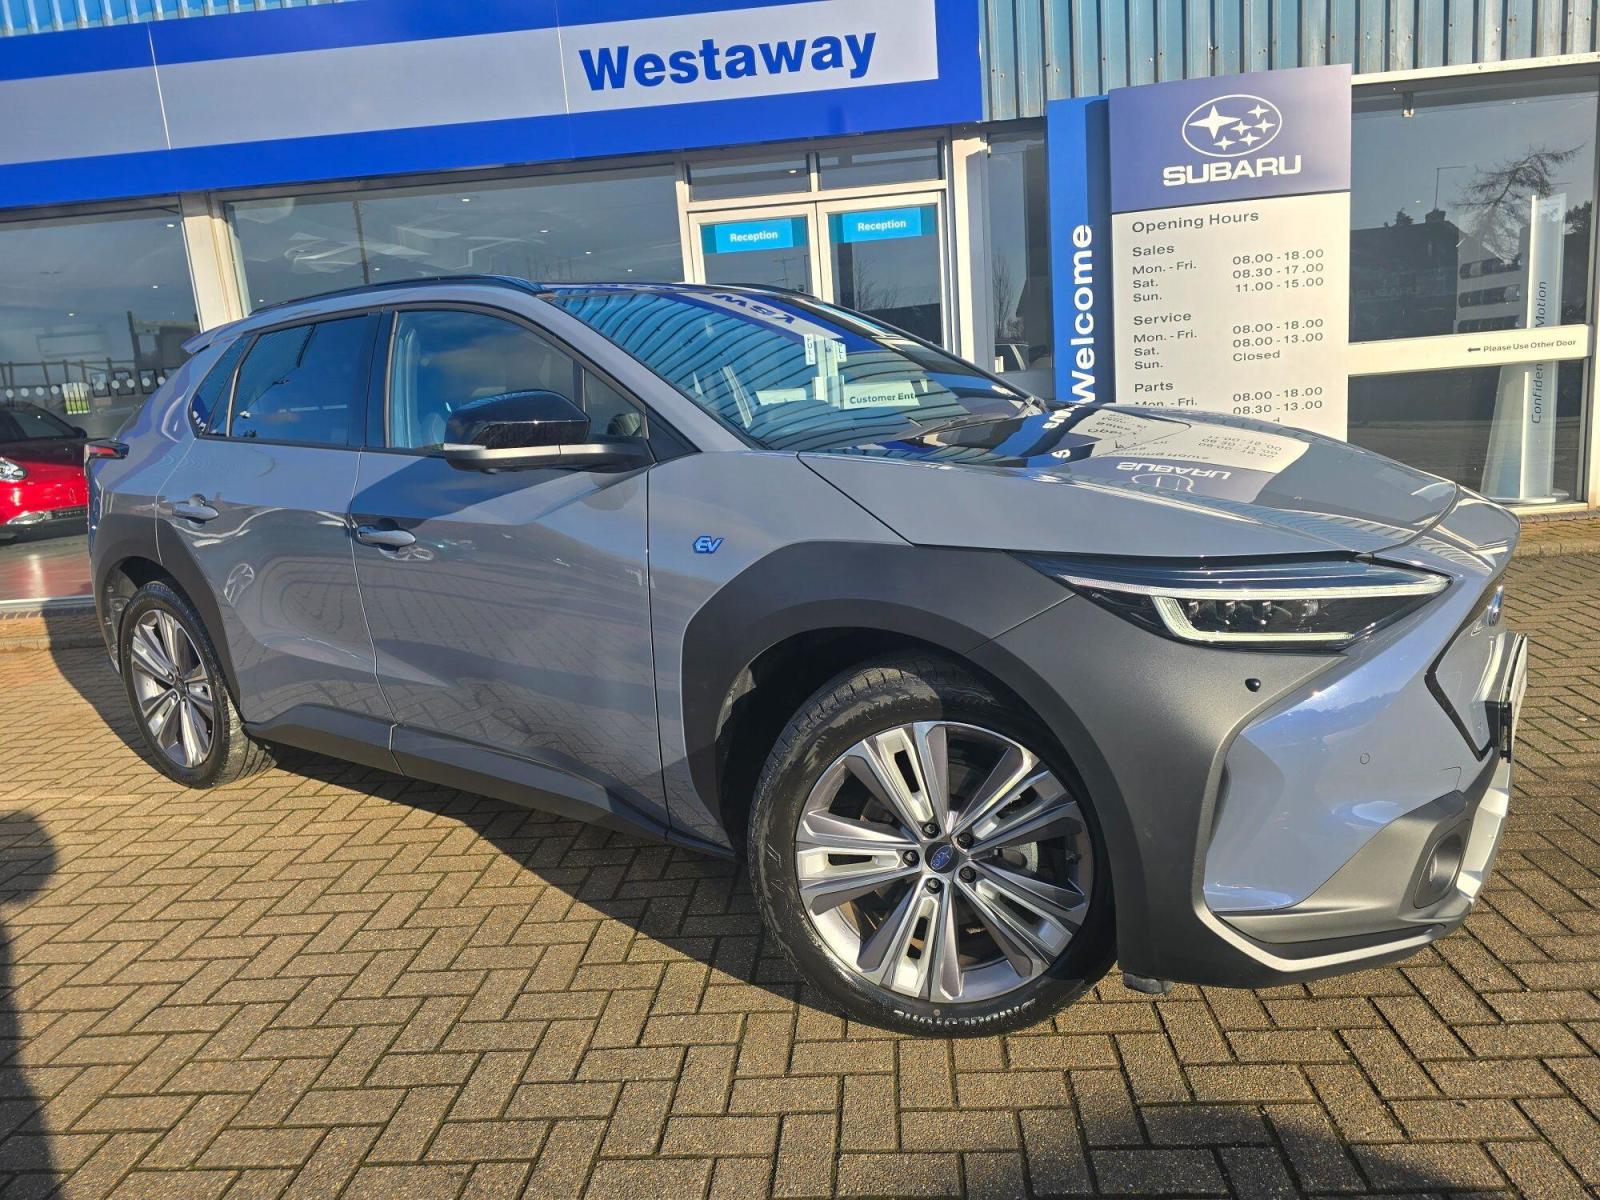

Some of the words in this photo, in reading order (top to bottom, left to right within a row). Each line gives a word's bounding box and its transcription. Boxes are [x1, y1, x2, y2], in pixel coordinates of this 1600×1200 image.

[578, 32, 877, 91] Westaway
[1163, 155, 1302, 187] SUBARU
[857, 219, 907, 232] Reception
[1132, 217, 1204, 234] Opening
[1209, 212, 1259, 225] Hours
[729, 230, 778, 242] Reception
[1132, 245, 1175, 257] Sales
[1232, 253, 1273, 265] 08.00
[1284, 249, 1324, 261] 18.00
[1132, 265, 1166, 275] Mon.
[1176, 260, 1197, 271] Fri.
[1232, 267, 1273, 279] 08.30
[1284, 263, 1324, 275] 17.00
[1133, 278, 1159, 289] Sat.
[1236, 281, 1273, 293] 11.00
[1284, 277, 1324, 289] 15.00
[1133, 293, 1163, 303] Sun.
[1535, 281, 1547, 327] Motion
[1071, 225, 1096, 404] Welcome
[1133, 313, 1192, 326] Service
[1232, 322, 1273, 334] 08.00
[1284, 318, 1324, 330] 18.00
[1133, 333, 1167, 344] Mon.
[1177, 330, 1198, 340] Fri.
[1232, 336, 1273, 348] 08.00
[1284, 332, 1323, 344] 13.00
[1134, 347, 1160, 357] Sat.
[1483, 344, 1512, 353] Please
[1513, 342, 1530, 350] Use
[1530, 341, 1555, 349] Other
[1232, 350, 1281, 361] Closed
[1134, 361, 1164, 370] Sun.
[1135, 382, 1174, 393] Parts
[1232, 391, 1273, 402] 08.00
[1284, 386, 1323, 398] 18.00
[849, 393, 895, 404] Customer
[1178, 397, 1198, 407] Fri.
[692, 535, 724, 554] EV
